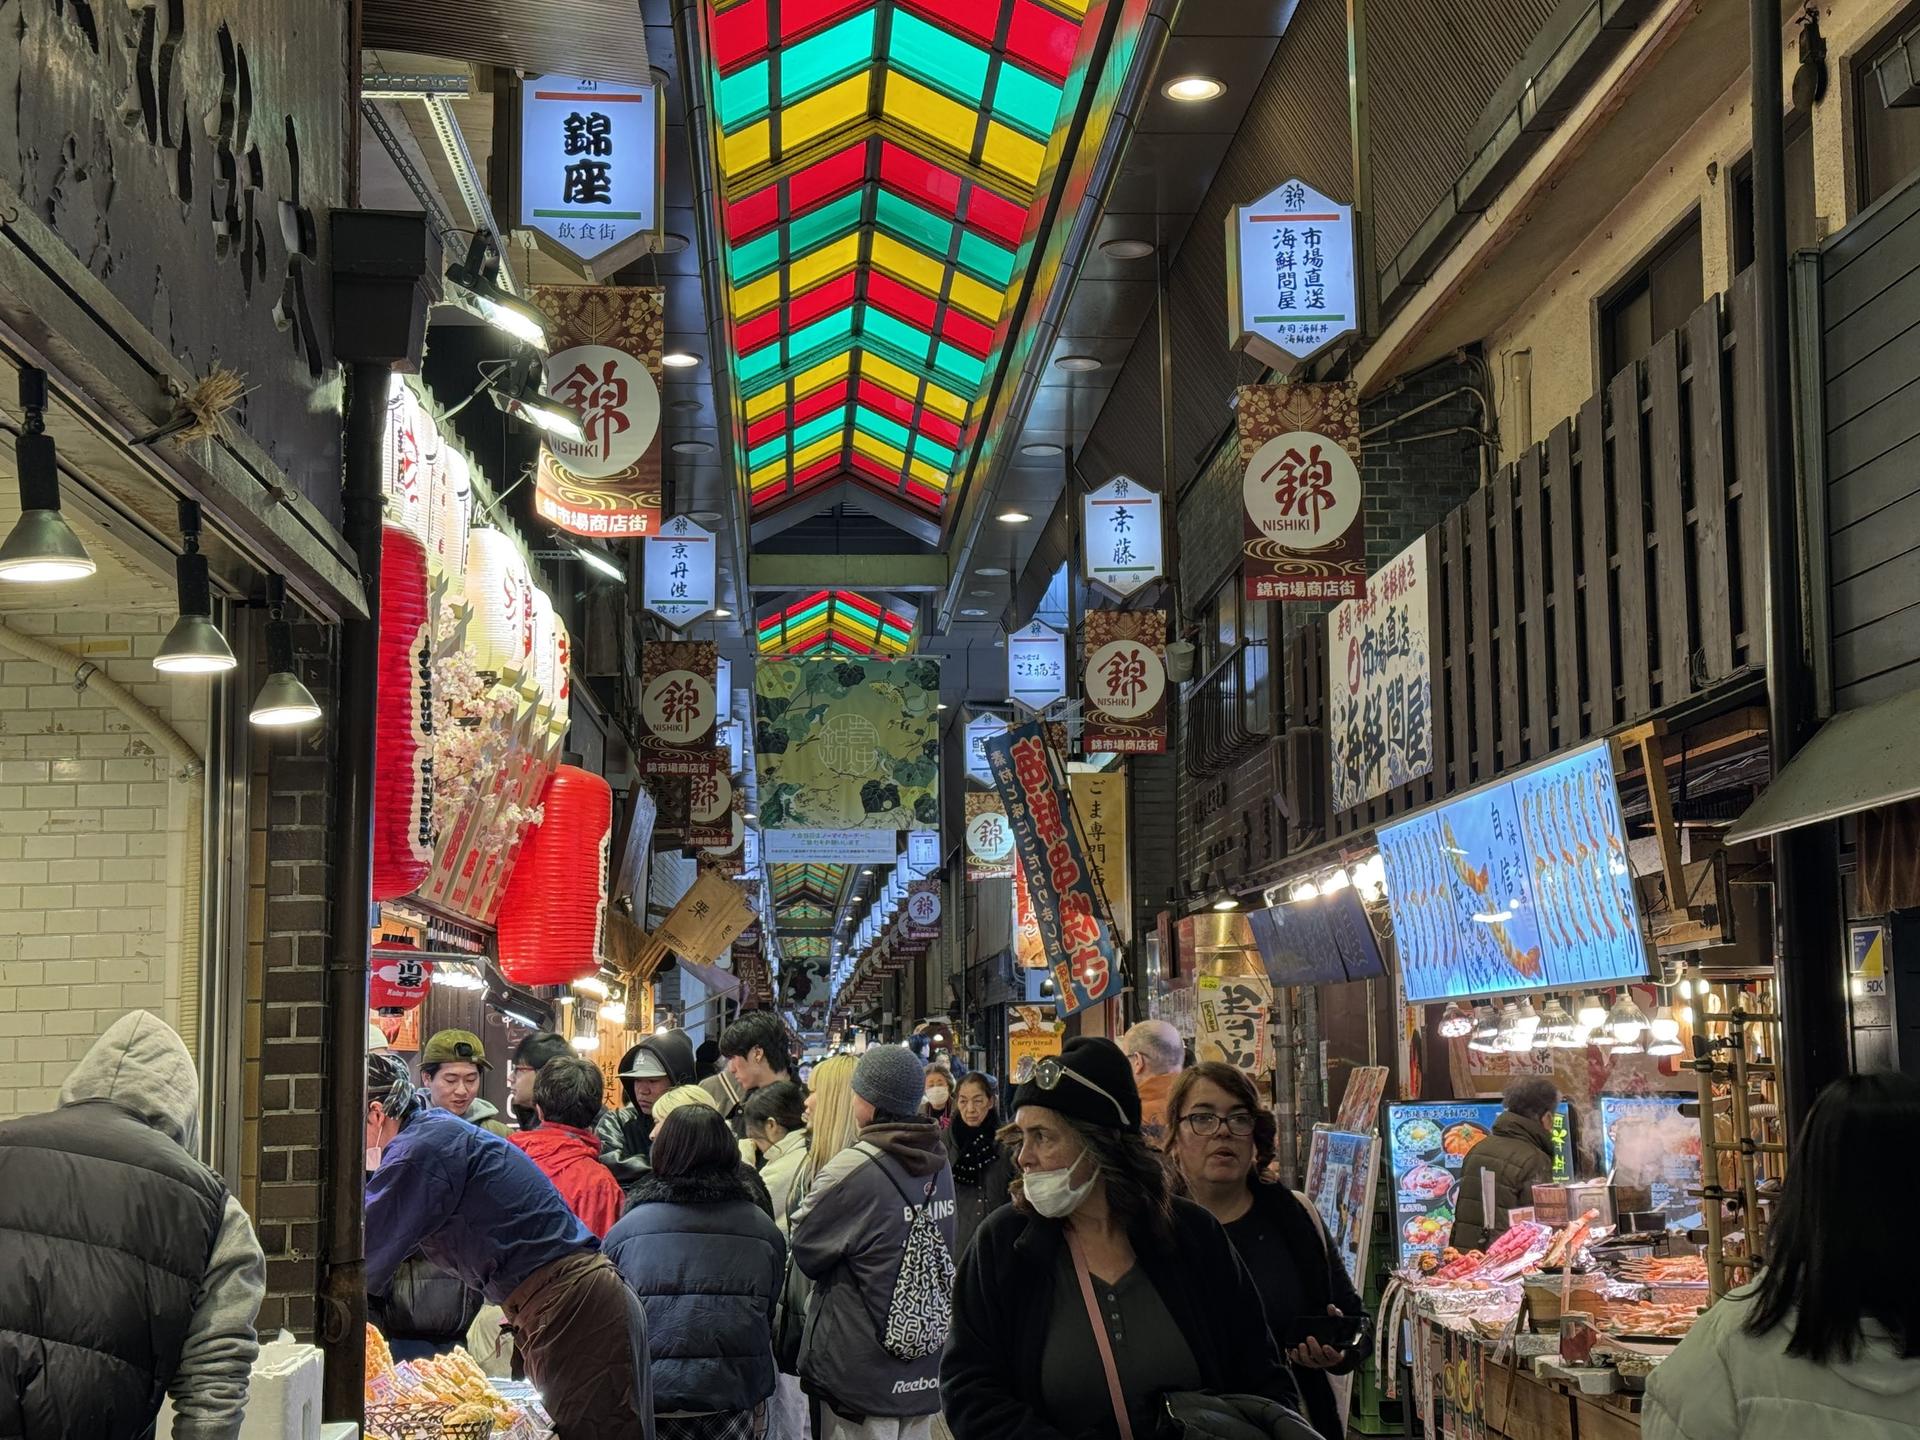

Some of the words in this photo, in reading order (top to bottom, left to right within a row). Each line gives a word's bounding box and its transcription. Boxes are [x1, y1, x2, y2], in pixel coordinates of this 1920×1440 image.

[563, 112, 612, 204] 錦座
[1280, 183, 1306, 212] 錦
[558, 222, 616, 240] 飲食街
[1272, 228, 1298, 310] 海鮮問屋
[1301, 227, 1326, 309] 市場直送
[1277, 324, 1296, 333] 寿司
[1299, 323, 1328, 333] 海鮮丼
[1284, 334, 1321, 344] 海鮮焼き
[551, 359, 631, 463] 錦
[551, 437, 599, 458] NISHIKI
[1260, 444, 1337, 536] 錦
[1263, 519, 1310, 531] NISHIKI
[670, 542, 689, 598] 京丹波
[1256, 580, 1356, 597] 錦市場商店街
[1337, 604, 1352, 642] 寿司
[1380, 553, 1417, 606] 海鮮焼き
[1361, 603, 1411, 690] 市場直送
[1097, 648, 1148, 708] 錦
[654, 678, 700, 734] 錦
[1097, 697, 1130, 706] NISHIKI
[652, 723, 683, 732] NISHIKI
[1091, 739, 1159, 751] 錦市場商店街
[1337, 673, 1427, 801] 海鮮問屋
[646, 763, 709, 773] 錦市場商店街
[691, 774, 719, 815] 錦
[689, 836, 728, 845] 市場商店街
[973, 817, 1003, 855] 錦
[1087, 780, 1106, 886] ごま専門店
[1012, 1039, 1032, 1047] Curry
